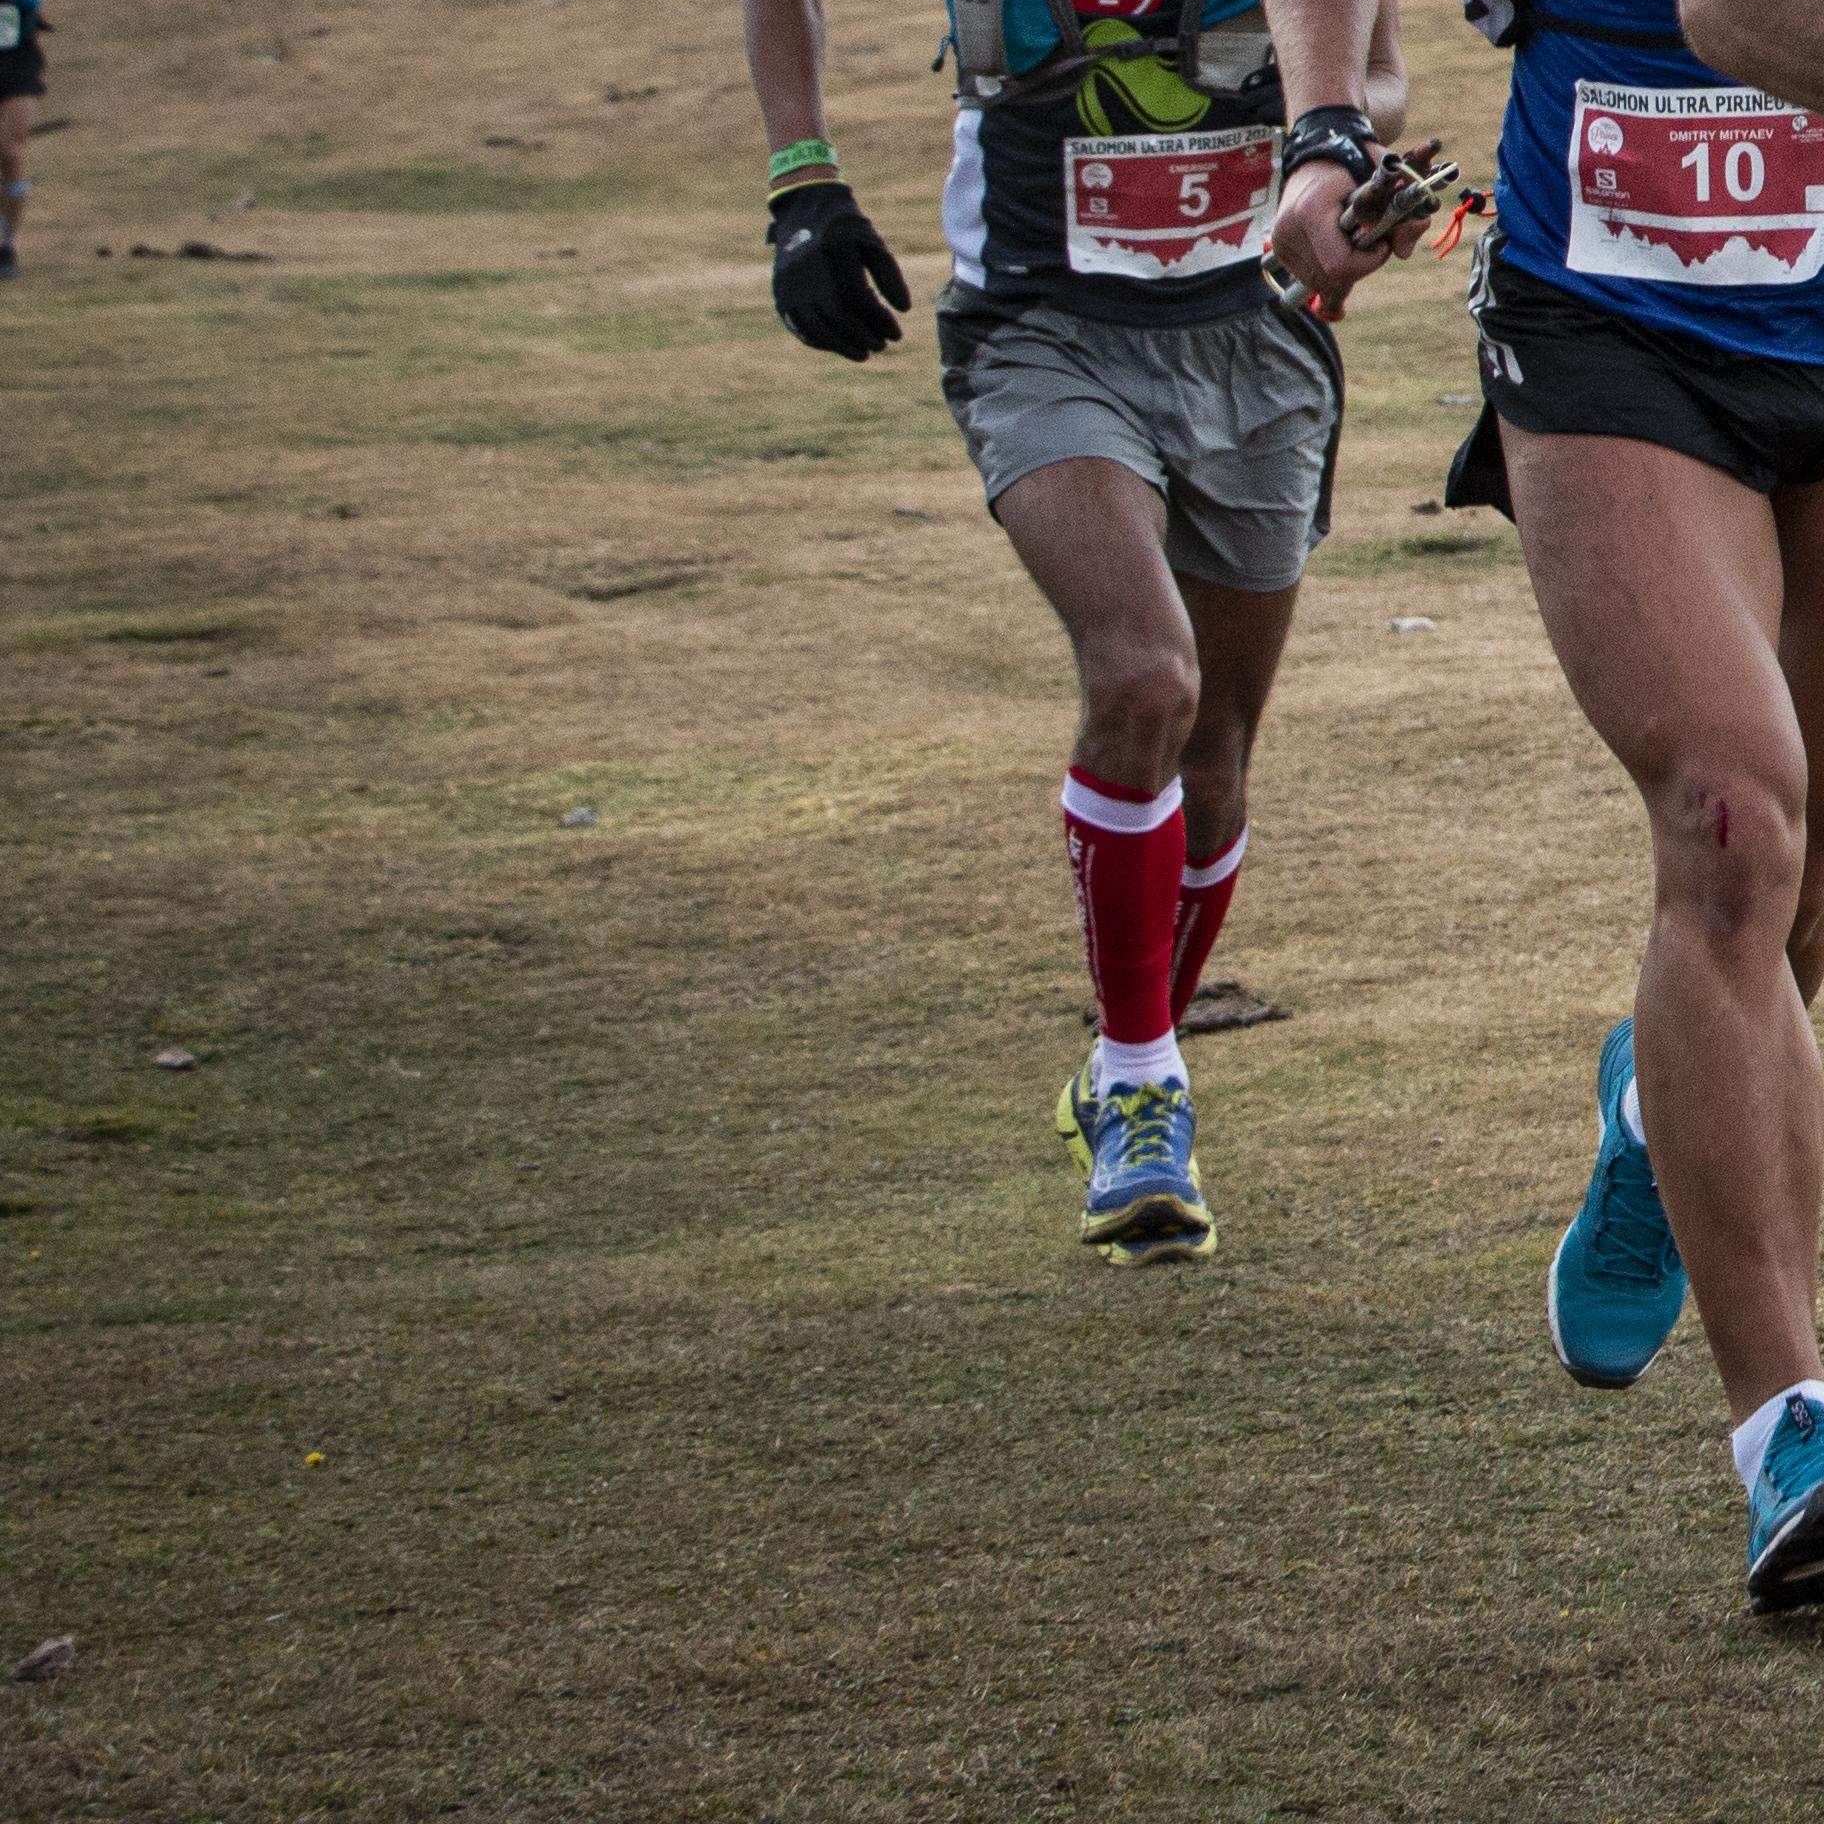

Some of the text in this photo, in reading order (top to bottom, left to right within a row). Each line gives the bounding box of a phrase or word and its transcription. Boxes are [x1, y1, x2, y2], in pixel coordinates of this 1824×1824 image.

[1580, 86, 1649, 112] SALOMON
[1655, 95, 1711, 114] ULTRA
[1071, 139, 1135, 154] SALOMON
[1141, 135, 1184, 153] ULTRA
[1188, 132, 1240, 150] PIRINEU
[1669, 128, 1774, 142] DMITRY MITYAEV
[1681, 141, 1765, 202] 10
[1178, 173, 1210, 218] 5
